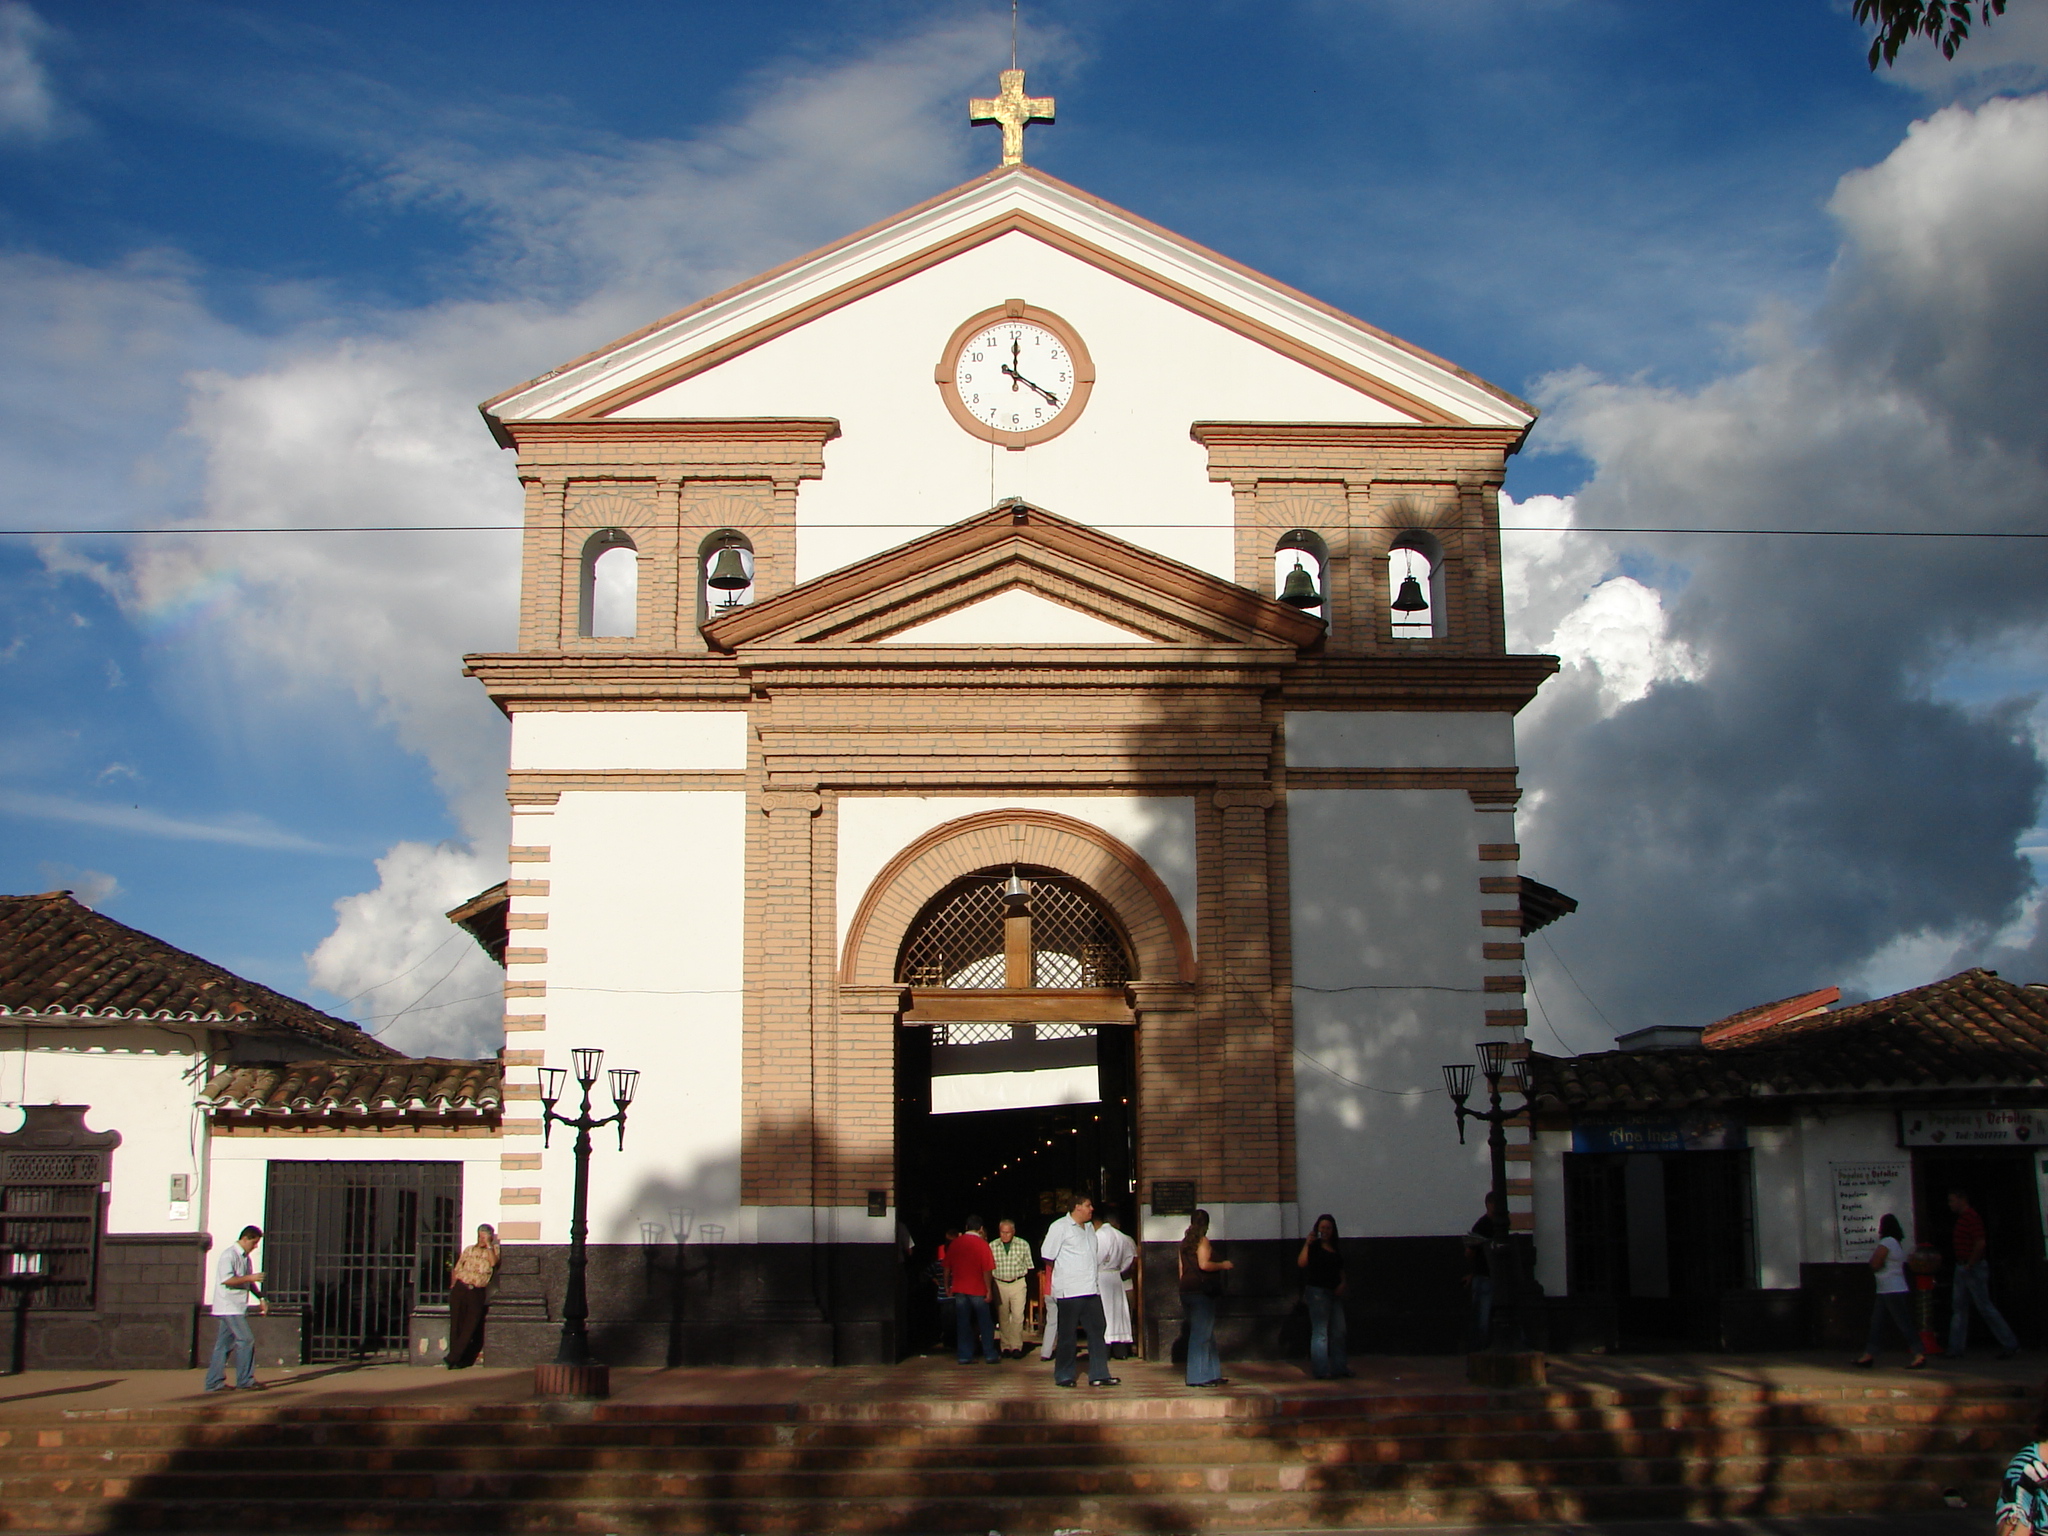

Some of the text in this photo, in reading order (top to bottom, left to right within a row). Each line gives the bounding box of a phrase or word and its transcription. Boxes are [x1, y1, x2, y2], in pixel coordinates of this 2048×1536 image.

[1009, 330, 1022, 341] 12
[1035, 336, 1040, 346] 1
[986, 337, 997, 347] 11
[971, 352, 984, 362] 10
[1051, 349, 1058, 360] 2
[964, 373, 972, 384] 9
[1059, 372, 1066, 383] 3
[972, 393, 980, 404] 8
[989, 408, 997, 419] 7
[1012, 413, 1020, 424] 6
[1034, 408, 1042, 418] 5
[1975, 1116, 1982, 1129] y
[1987, 1110, 2033, 1125] Detalles
[1609, 1126, 1643, 1145] Ana
